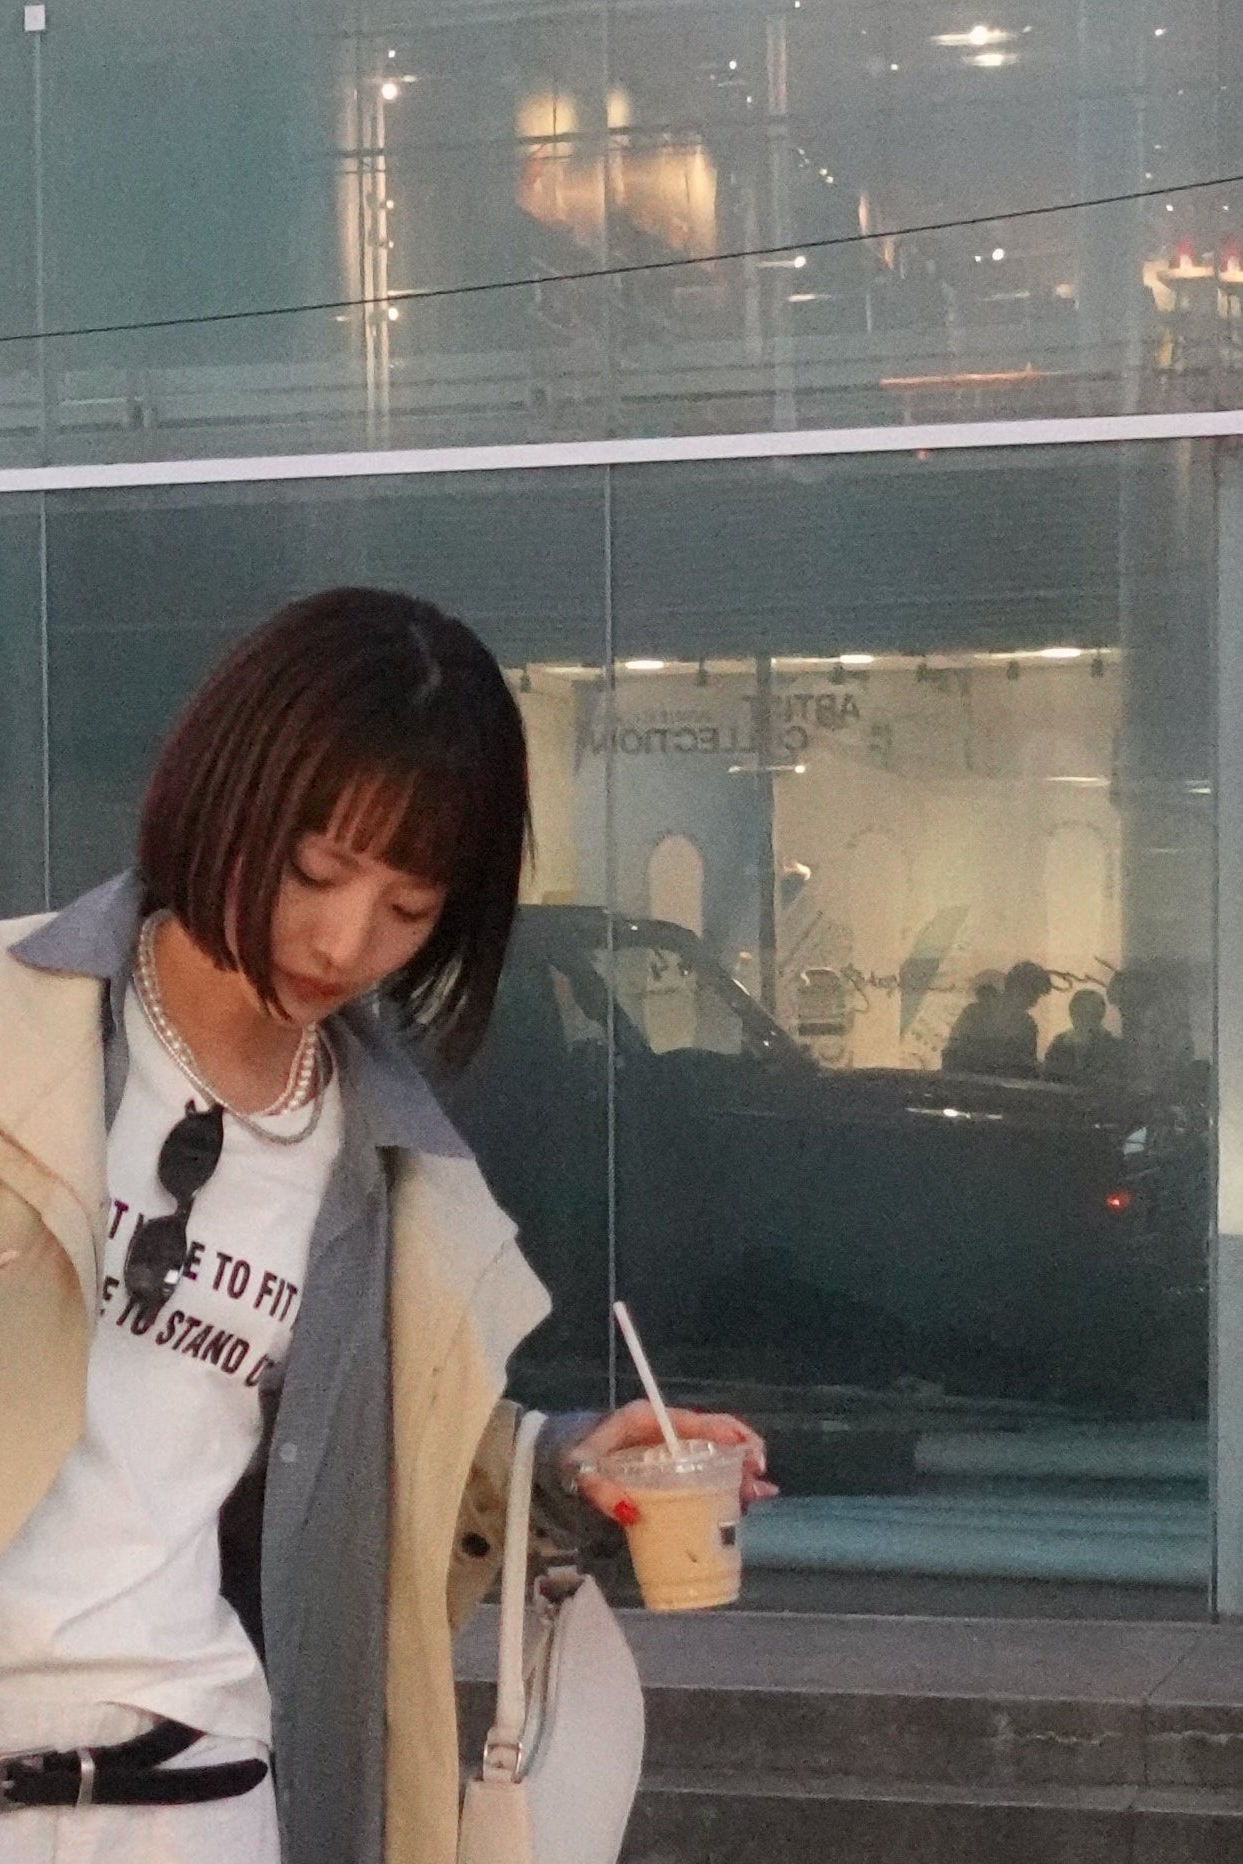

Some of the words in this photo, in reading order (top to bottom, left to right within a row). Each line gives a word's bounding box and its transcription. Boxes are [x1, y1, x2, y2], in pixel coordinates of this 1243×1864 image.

[212, 1251, 251, 1300] TO
[253, 1270, 298, 1322] FIT
[155, 1309, 250, 1375] STAND
